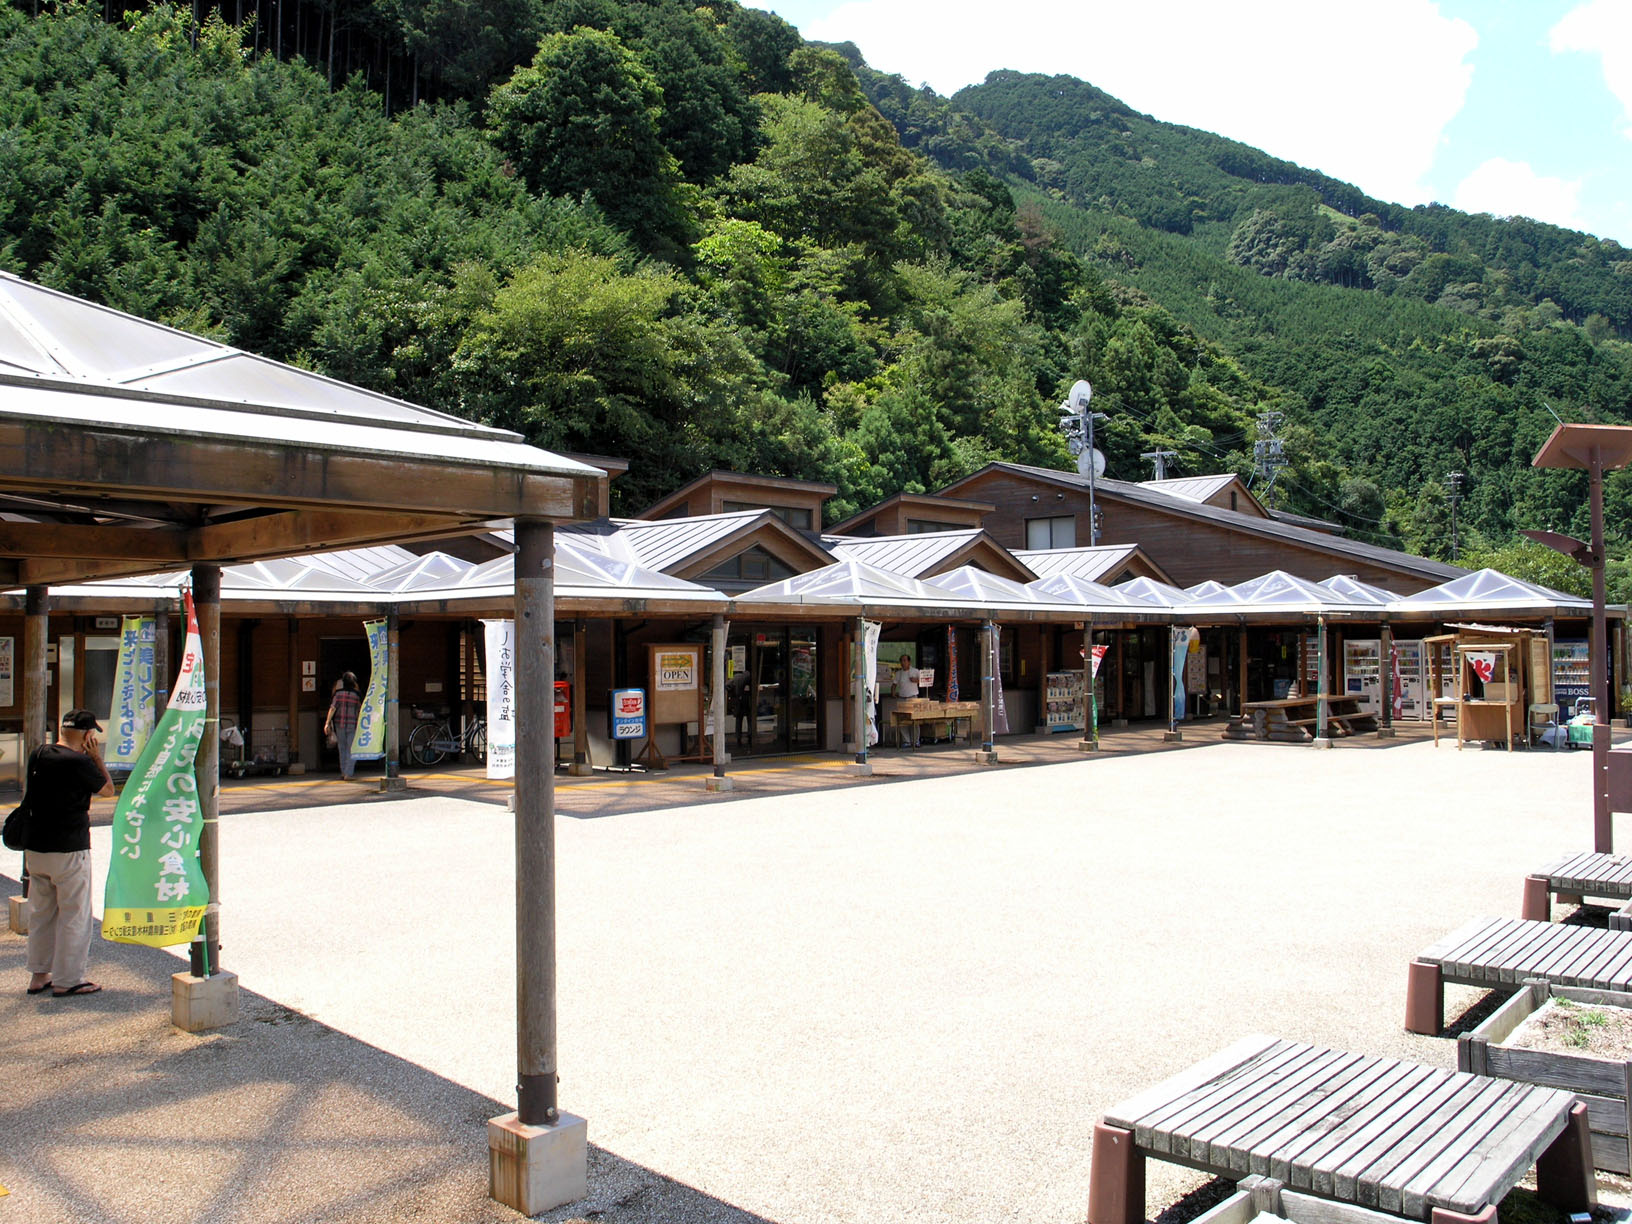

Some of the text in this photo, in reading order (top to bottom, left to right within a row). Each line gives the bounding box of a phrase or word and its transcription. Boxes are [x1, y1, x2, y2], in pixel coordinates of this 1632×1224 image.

[664, 671, 689, 680] OPEN
[1567, 688, 1589, 696] BOSS
[619, 726, 641, 735] ラウンジ
